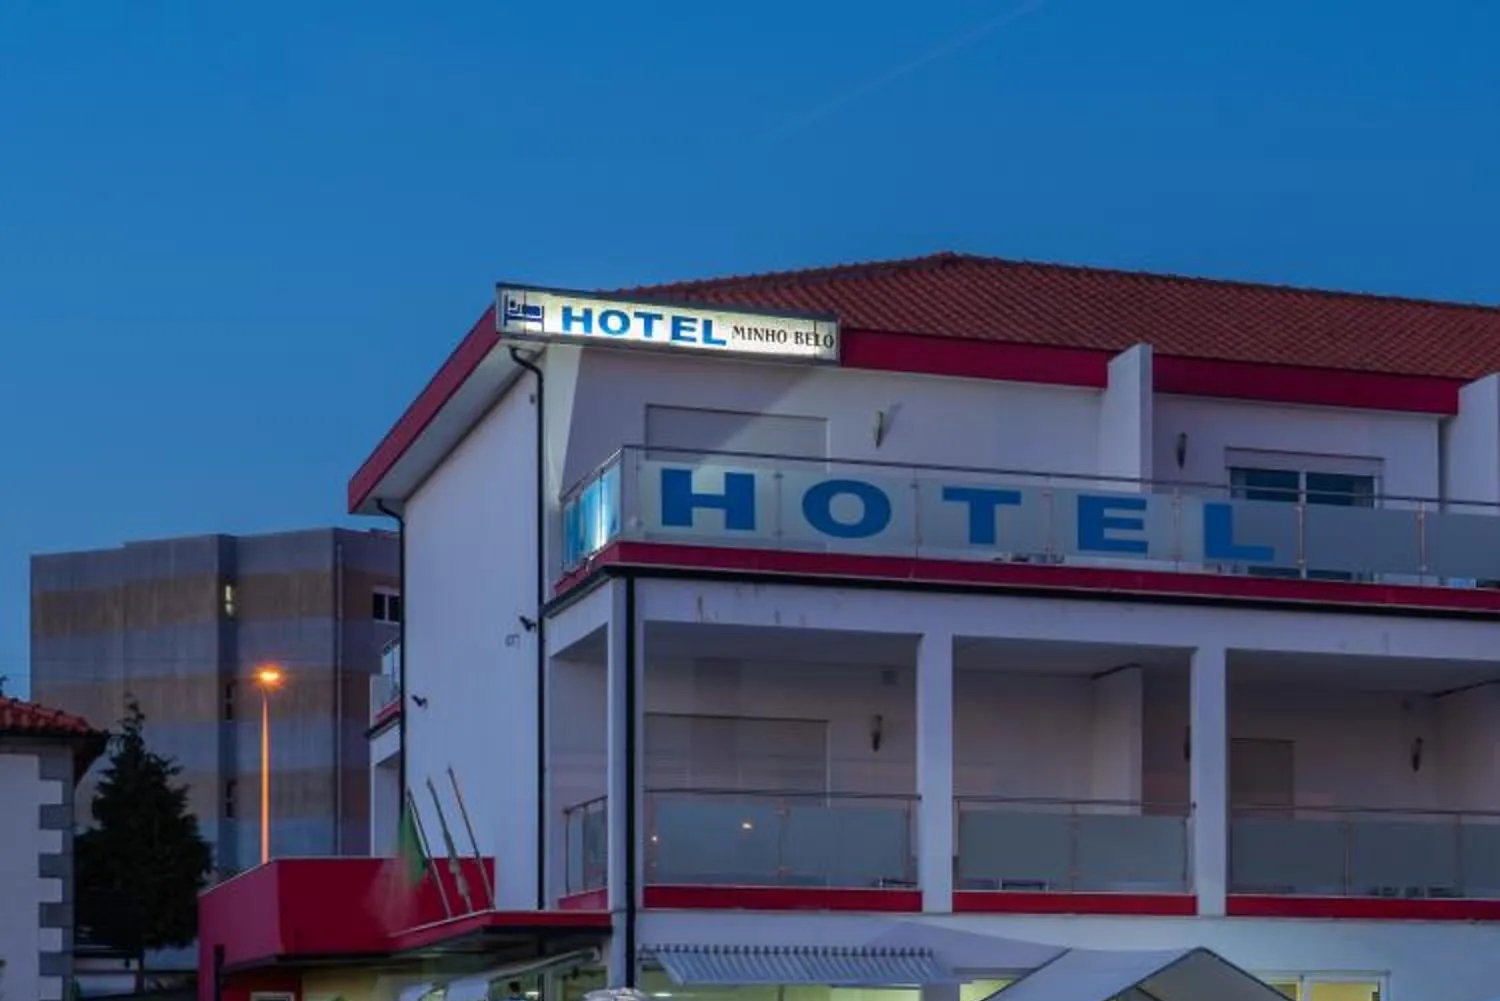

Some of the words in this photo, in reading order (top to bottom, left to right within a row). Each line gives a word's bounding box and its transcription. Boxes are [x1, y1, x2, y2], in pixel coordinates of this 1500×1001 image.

[561, 305, 727, 346] HOTEL
[732, 325, 787, 344] MINHO
[795, 331, 834, 348] BELO
[660, 467, 1275, 562] HOTEL
